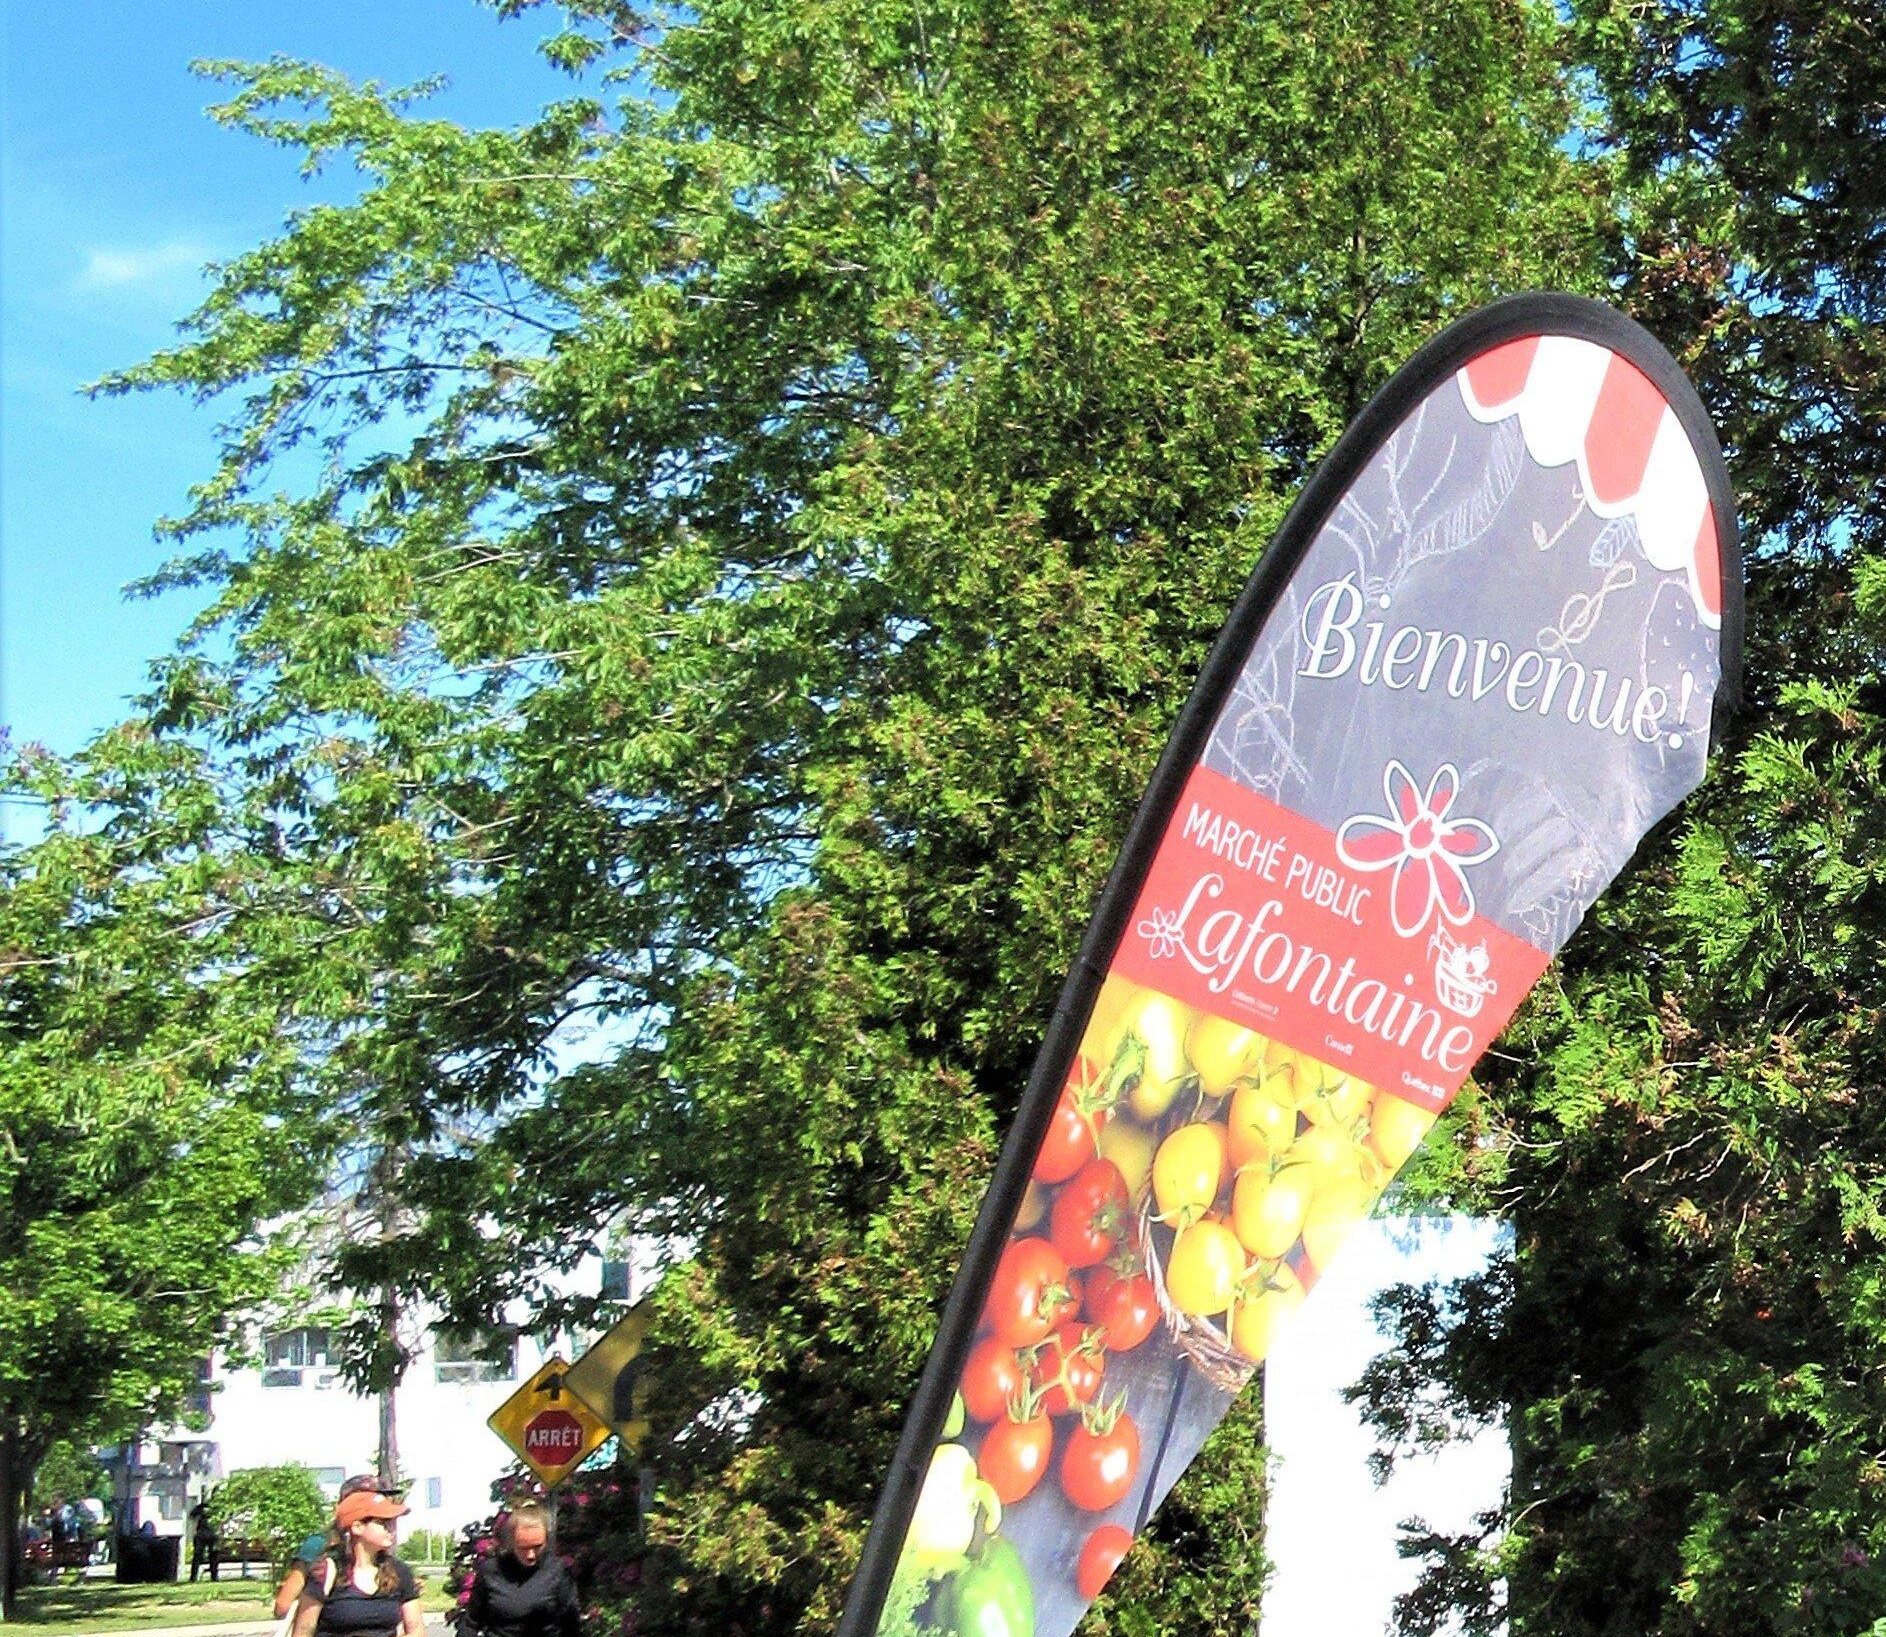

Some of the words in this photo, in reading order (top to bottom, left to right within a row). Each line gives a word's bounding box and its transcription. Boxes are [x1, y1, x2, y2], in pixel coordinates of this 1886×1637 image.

[1297, 569, 1695, 751] Bienvenue!
[1182, 801, 1286, 883] MARCHÉ
[1284, 853, 1372, 927] PUBLIC
[1174, 872, 1474, 1073] Lafontaine
[526, 1426, 581, 1447] ARRÊT
